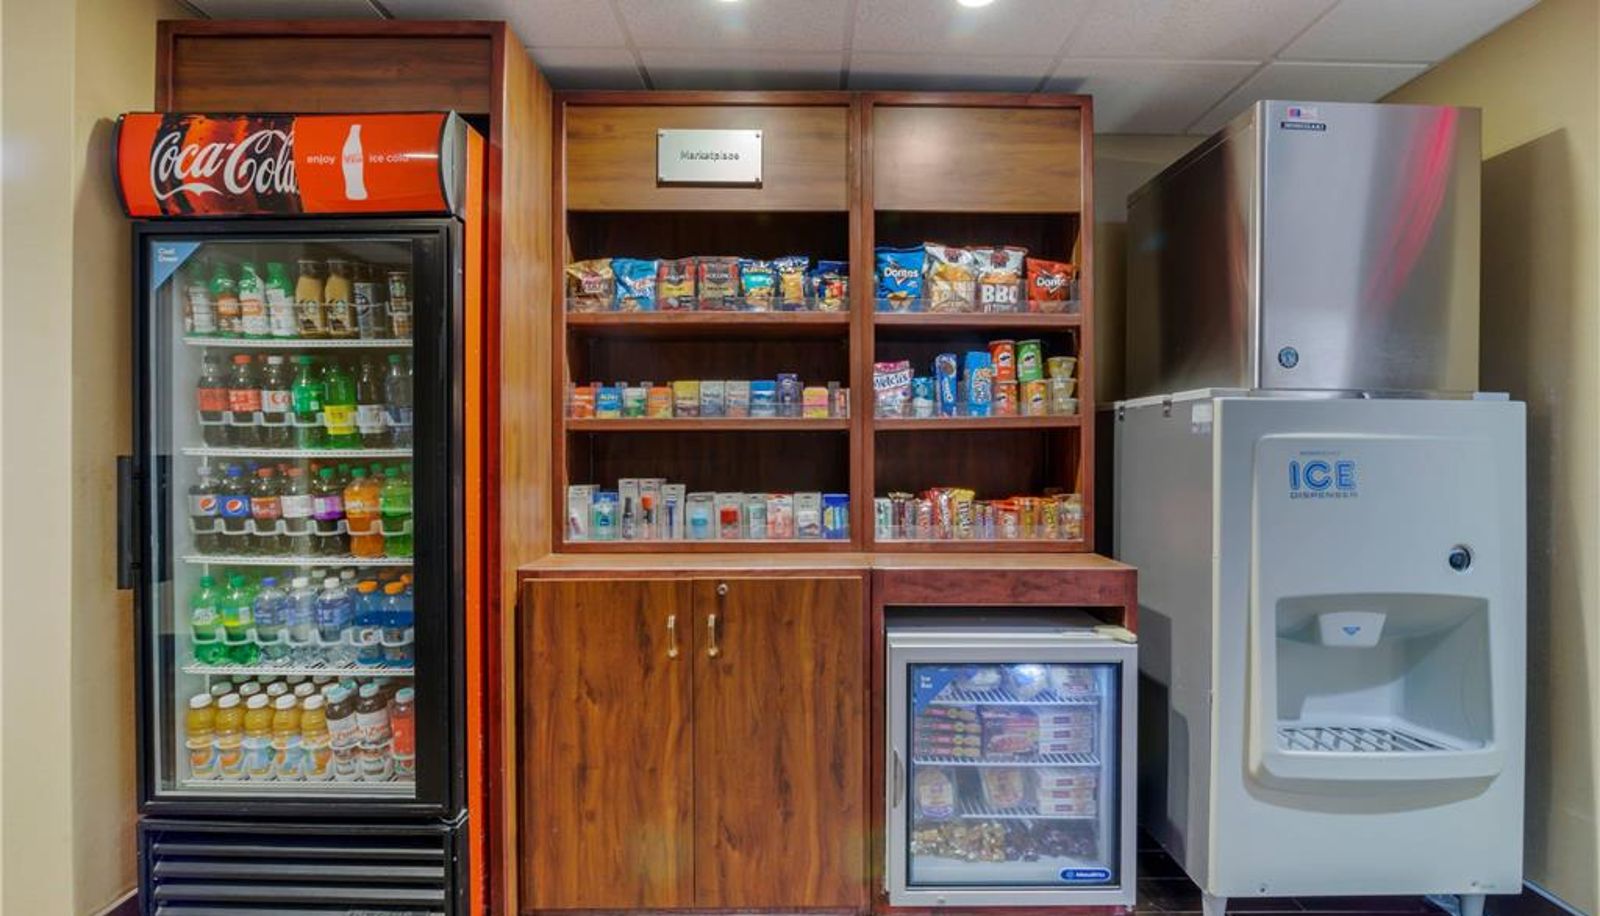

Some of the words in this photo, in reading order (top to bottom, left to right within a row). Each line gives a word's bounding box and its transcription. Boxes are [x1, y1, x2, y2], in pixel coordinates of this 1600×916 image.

[306, 154, 335, 165] enjoy
[369, 154, 384, 163] ice
[680, 150, 741, 162] Marketplace
[151, 129, 299, 200] Coca-Cola
[884, 267, 918, 278] Doritos
[1289, 460, 1356, 491] ICE
